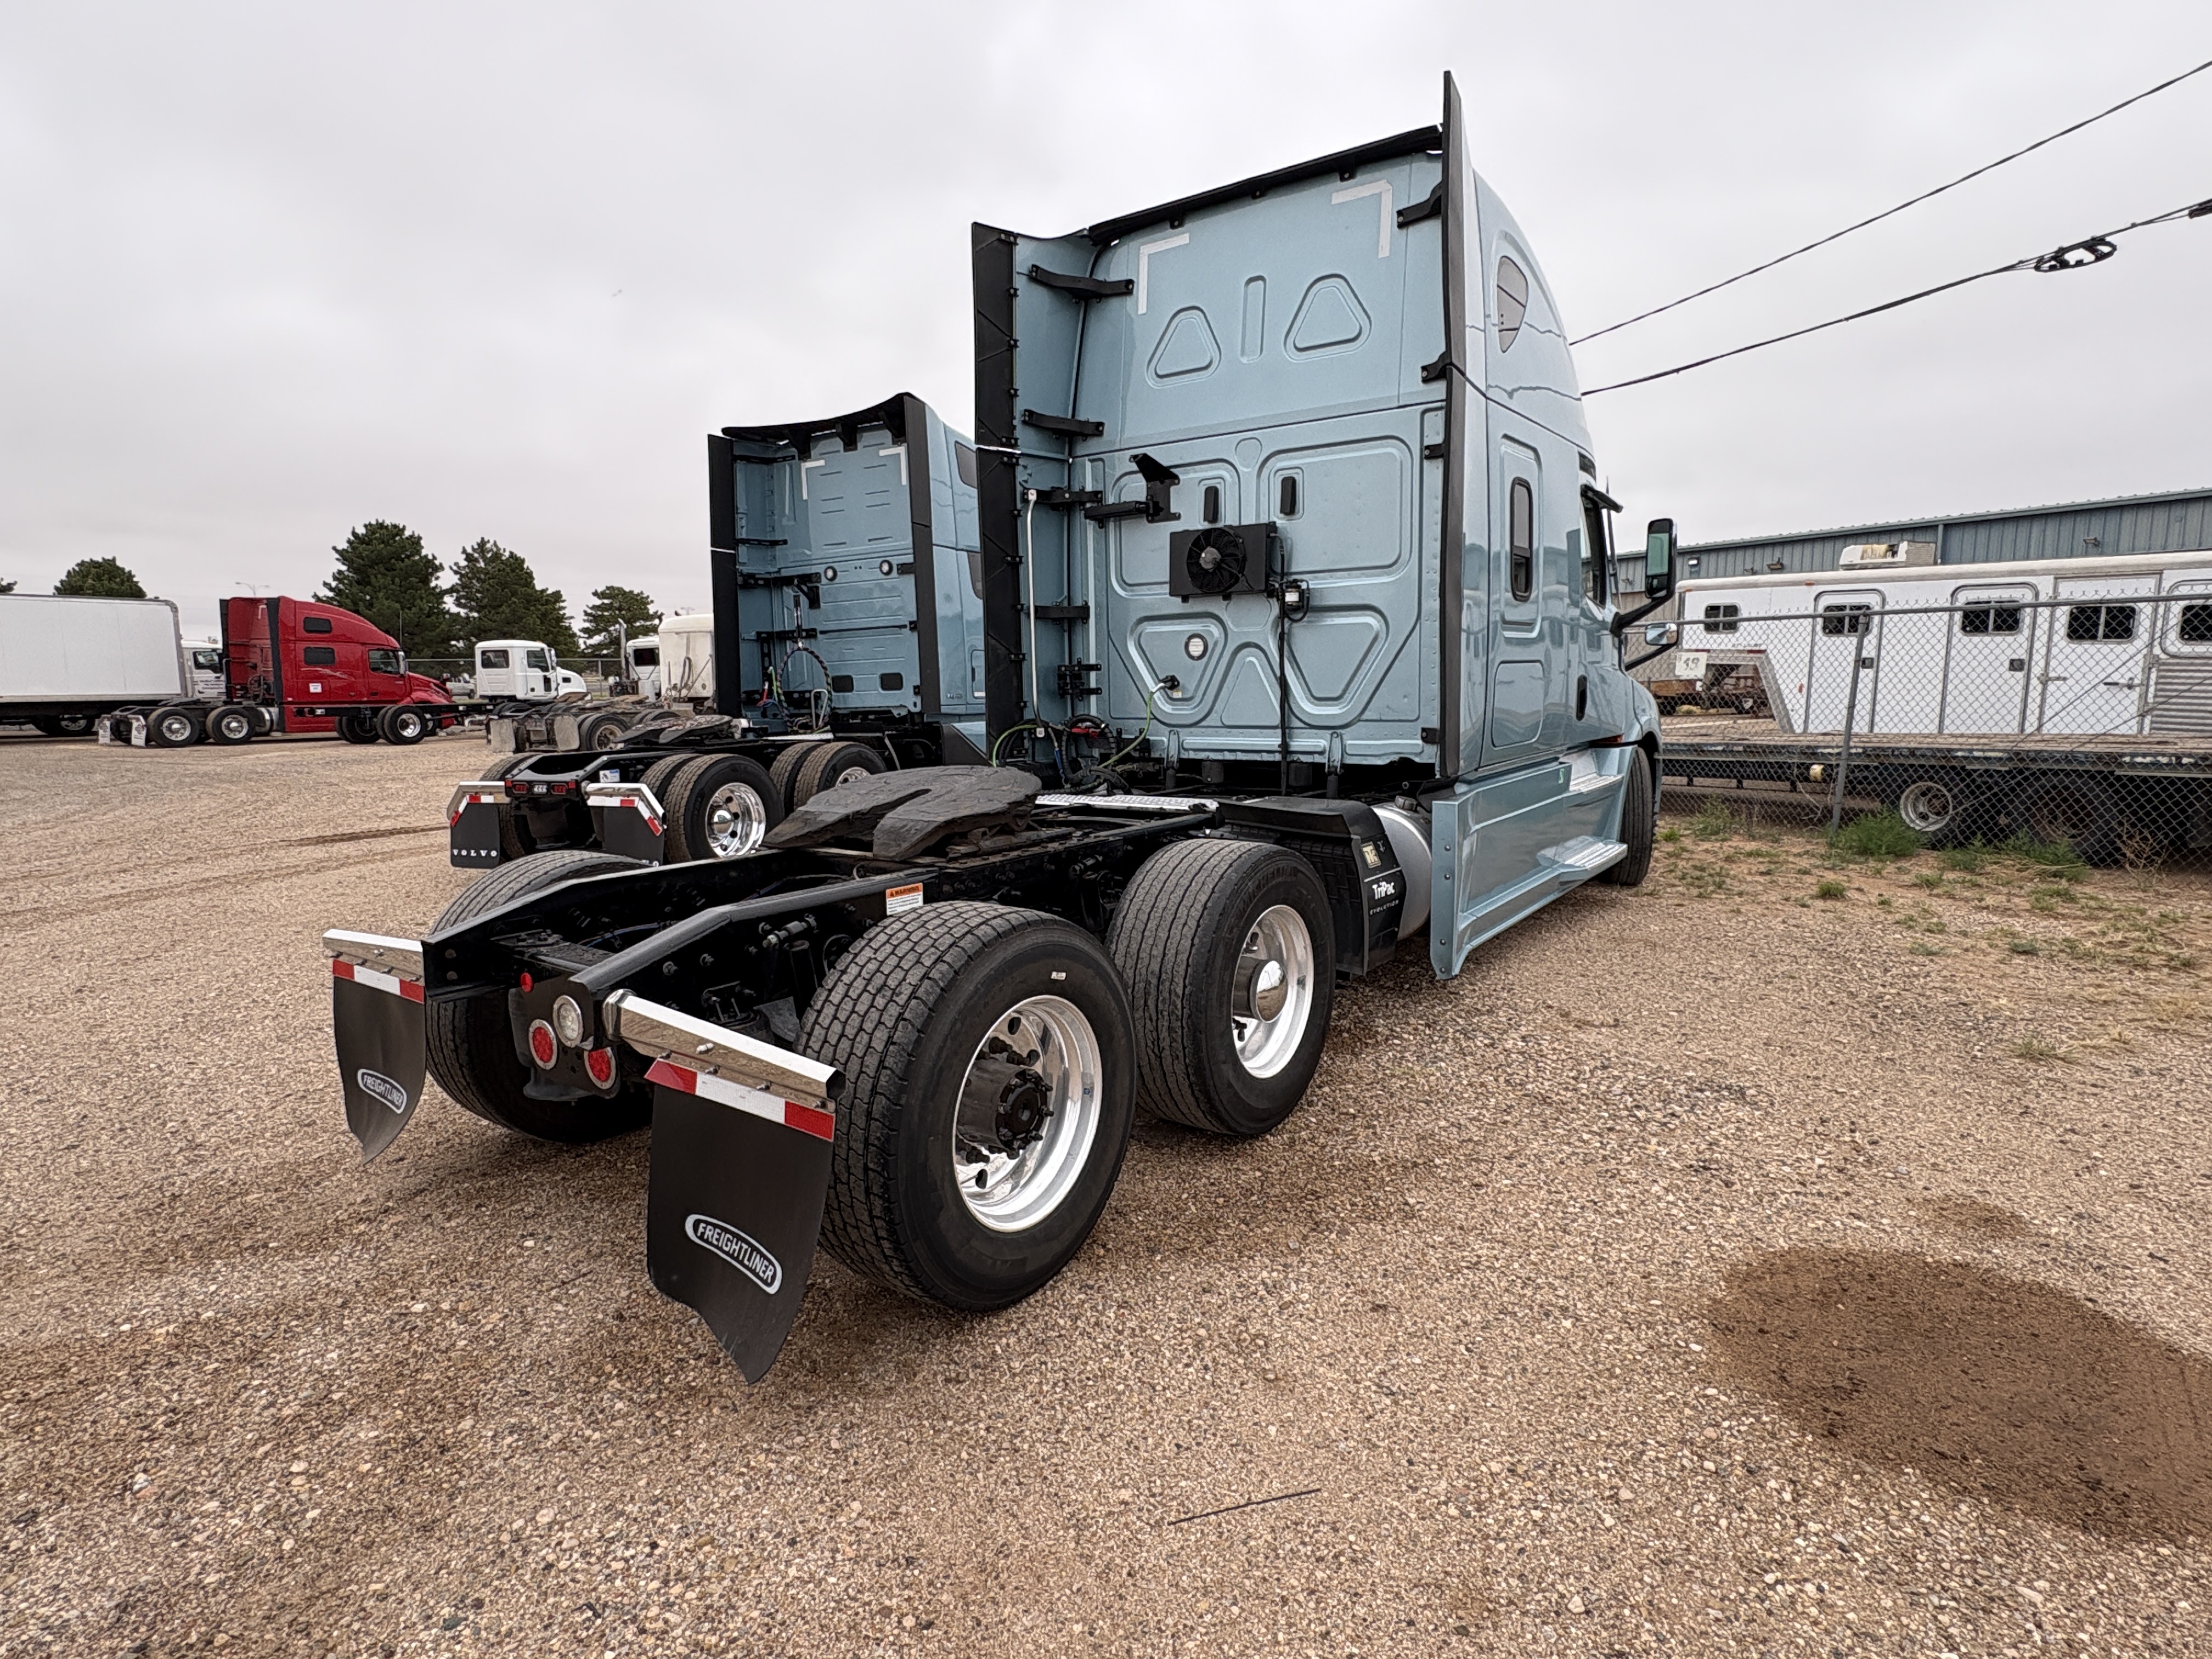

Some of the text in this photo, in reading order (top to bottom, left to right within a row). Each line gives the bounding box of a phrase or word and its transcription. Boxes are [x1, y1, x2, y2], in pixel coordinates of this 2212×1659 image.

[453, 849, 498, 857] VOLVO
[895, 885, 919, 895] WARNING
[1372, 881, 1395, 900] TriPac
[364, 1075, 403, 1106] FREIGHTLINER
[697, 1222, 775, 1283] FREIGHTLINER
